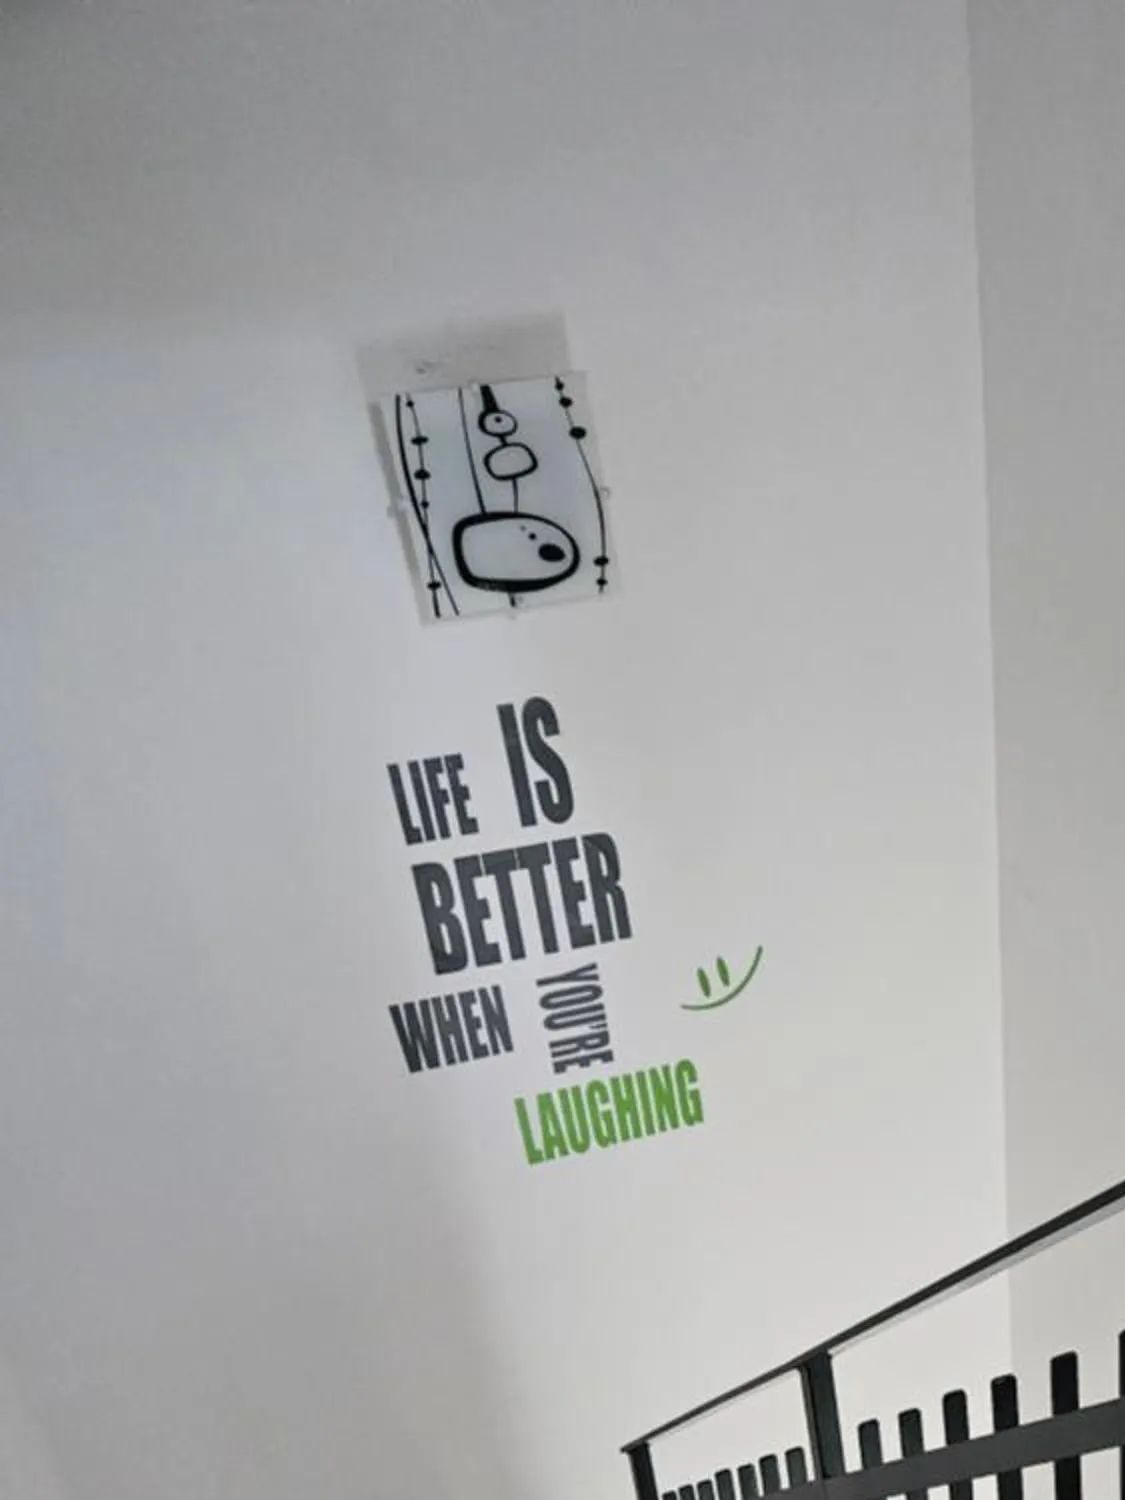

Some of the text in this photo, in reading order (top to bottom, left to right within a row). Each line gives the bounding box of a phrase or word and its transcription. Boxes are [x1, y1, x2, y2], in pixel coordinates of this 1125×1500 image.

[387, 696, 574, 846] LIFE IS
[411, 832, 633, 976] BETTER
[388, 985, 514, 1074] WHEN
[536, 963, 614, 1074] YOU'RE
[514, 1059, 704, 1165] LAUGHING
